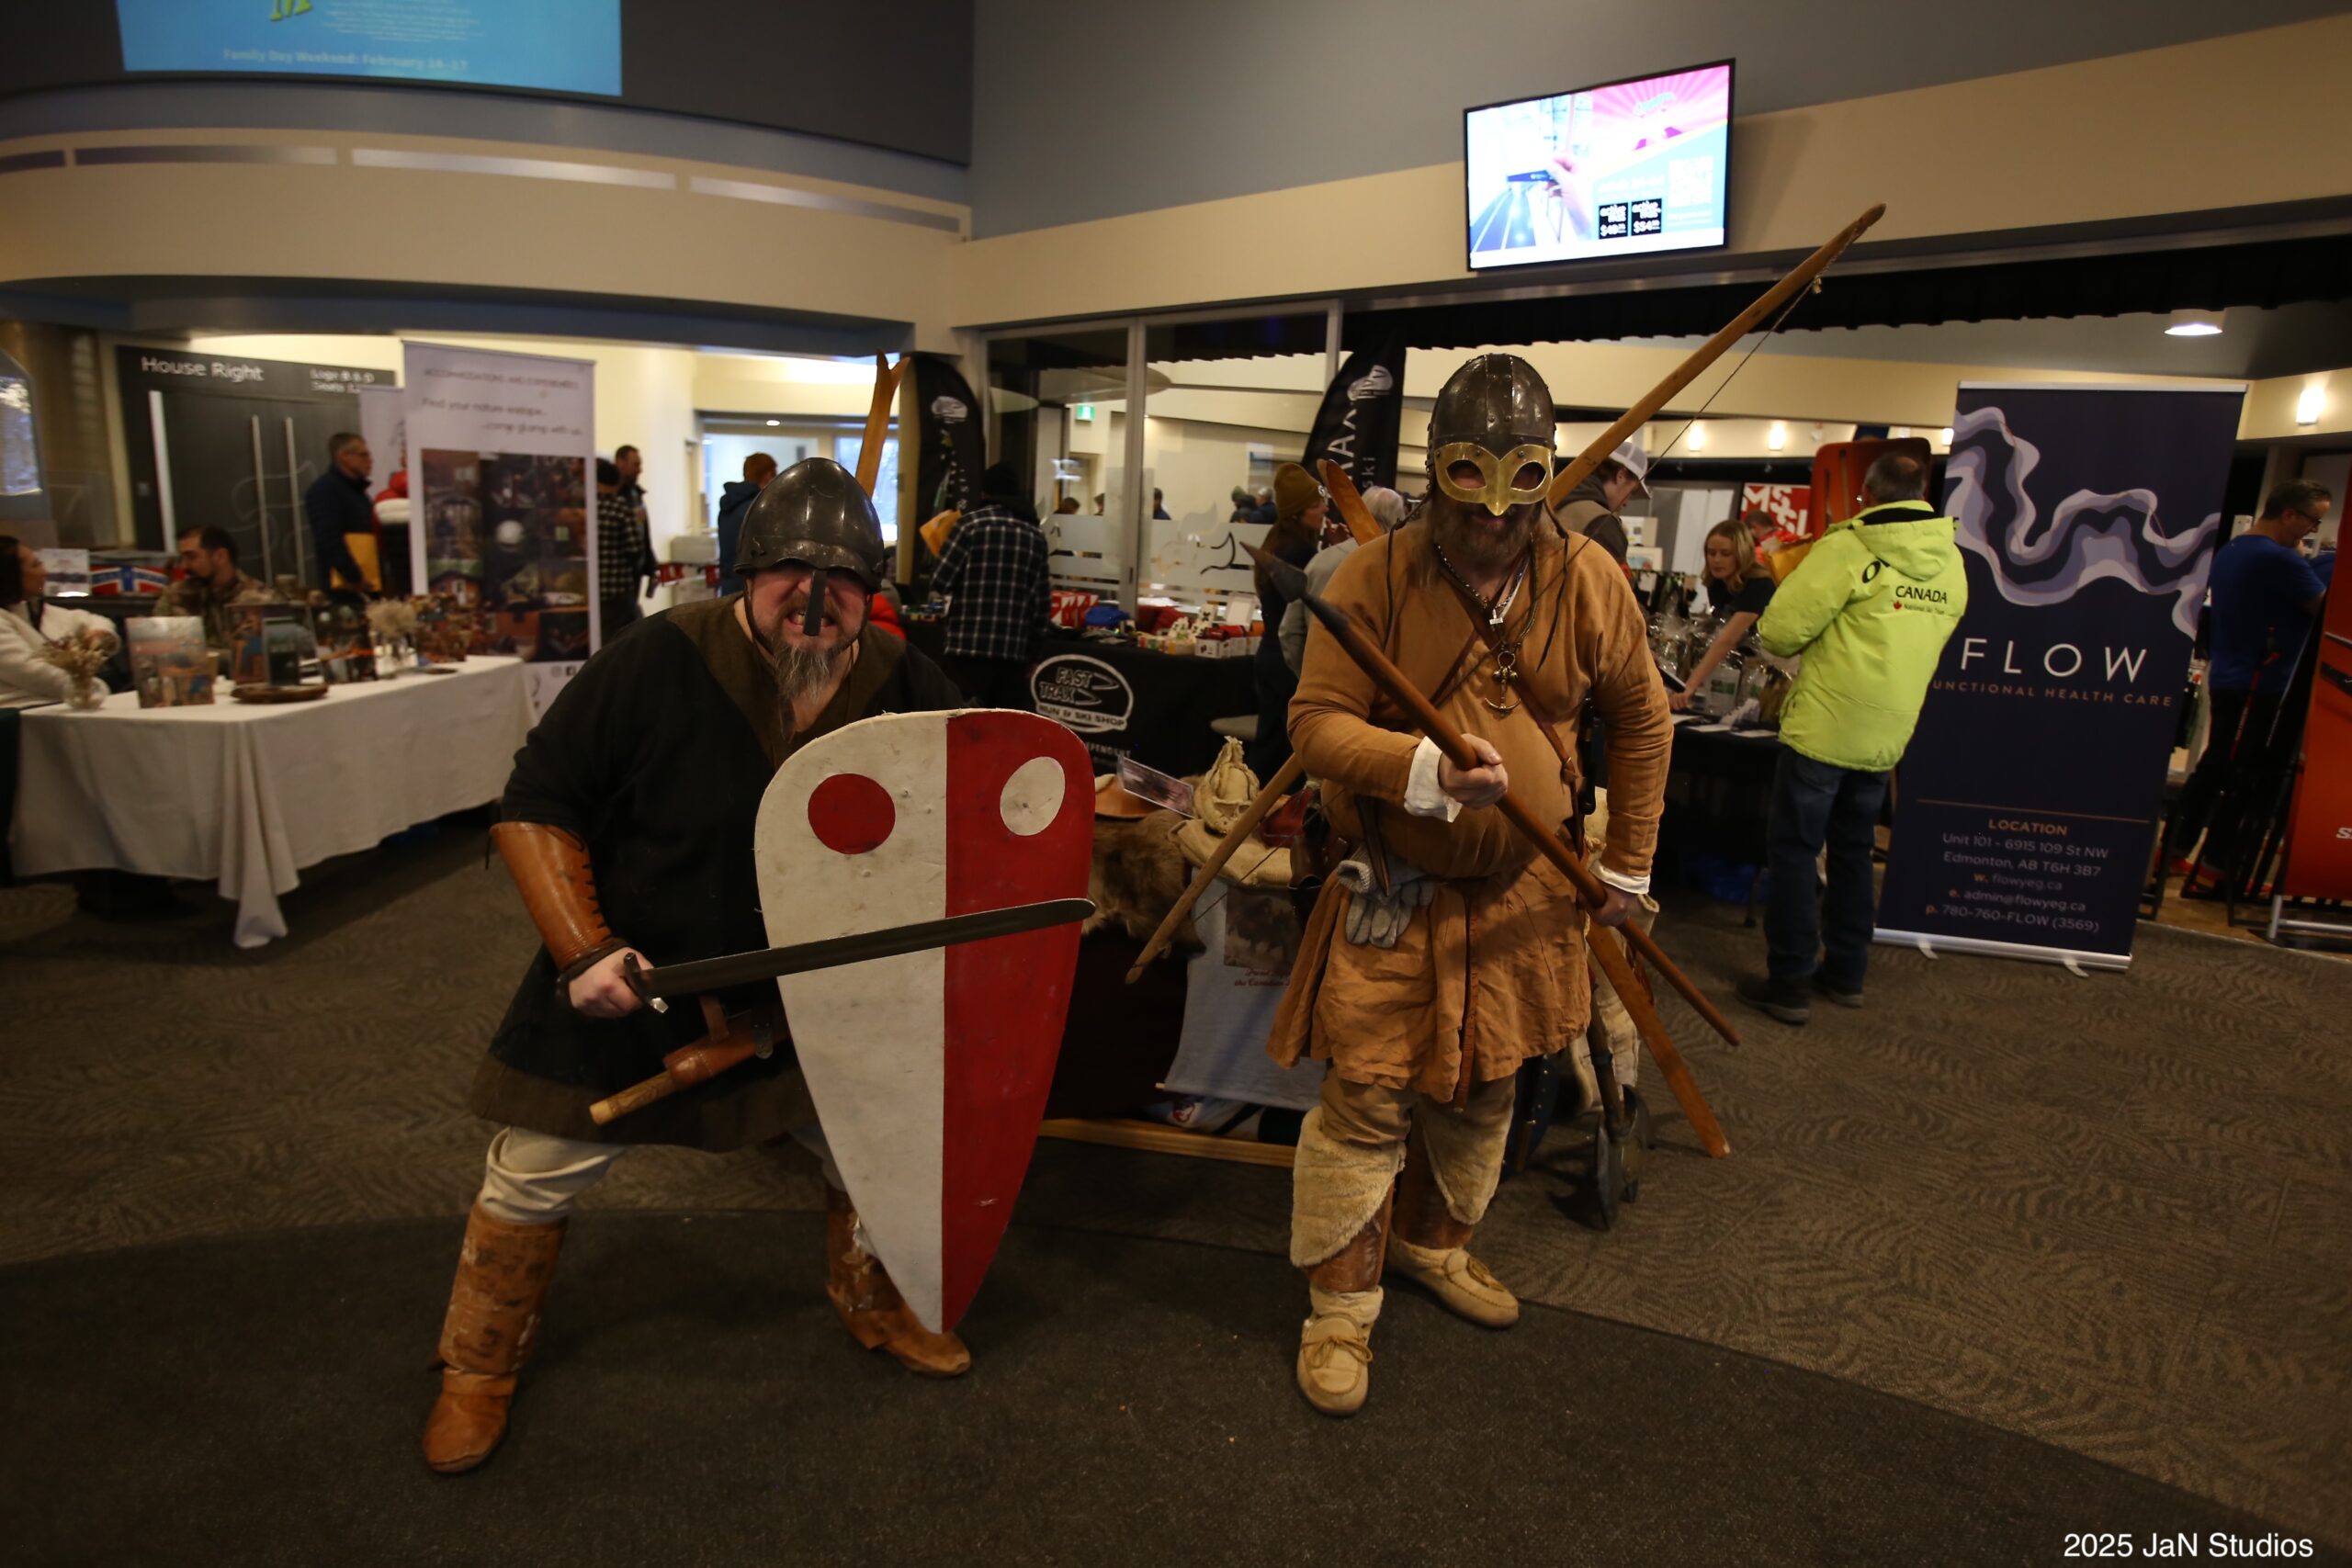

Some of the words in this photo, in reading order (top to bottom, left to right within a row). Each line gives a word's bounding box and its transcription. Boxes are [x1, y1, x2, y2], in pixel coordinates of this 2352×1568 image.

[141, 356, 206, 377] House
[211, 361, 265, 383] Right
[1895, 585, 1948, 604] CANADA
[1960, 637, 2147, 683] FLOW
[1057, 668, 1093, 688] FAST
[1039, 682, 1075, 704] TRAX
[1932, 679, 2036, 697] UNCTIONAL
[2044, 687, 2114, 703] HEALTH
[2123, 693, 2174, 707] CARE
[1038, 704, 1060, 716] RUN
[1075, 710, 1091, 722] SKI
[1095, 714, 1125, 728] SHOP
[1988, 818, 2068, 837] LOCATION
[1942, 832, 1969, 846] Unit
[1973, 835, 1992, 847] 101
[2004, 838, 2036, 852] 6915
[2040, 842, 2063, 854] 109
[2065, 844, 2081, 857] St
[2084, 846, 2109, 859] NW
[1943, 852, 2013, 869] Edmonton,
[2018, 860, 2038, 871] AB
[2042, 861, 2070, 874] T6H
[2074, 864, 2102, 877] 3B7
[1973, 873, 1988, 883] w.
[1992, 873, 2063, 891] flowyeg.ca
[1949, 888, 1961, 898] e.
[1963, 888, 2086, 912] admin@flowyeg.ca
[1926, 905, 1939, 917] p.
[1942, 904, 2050, 927] 780-760-FLOW
[2052, 917, 2100, 933] (3569)
